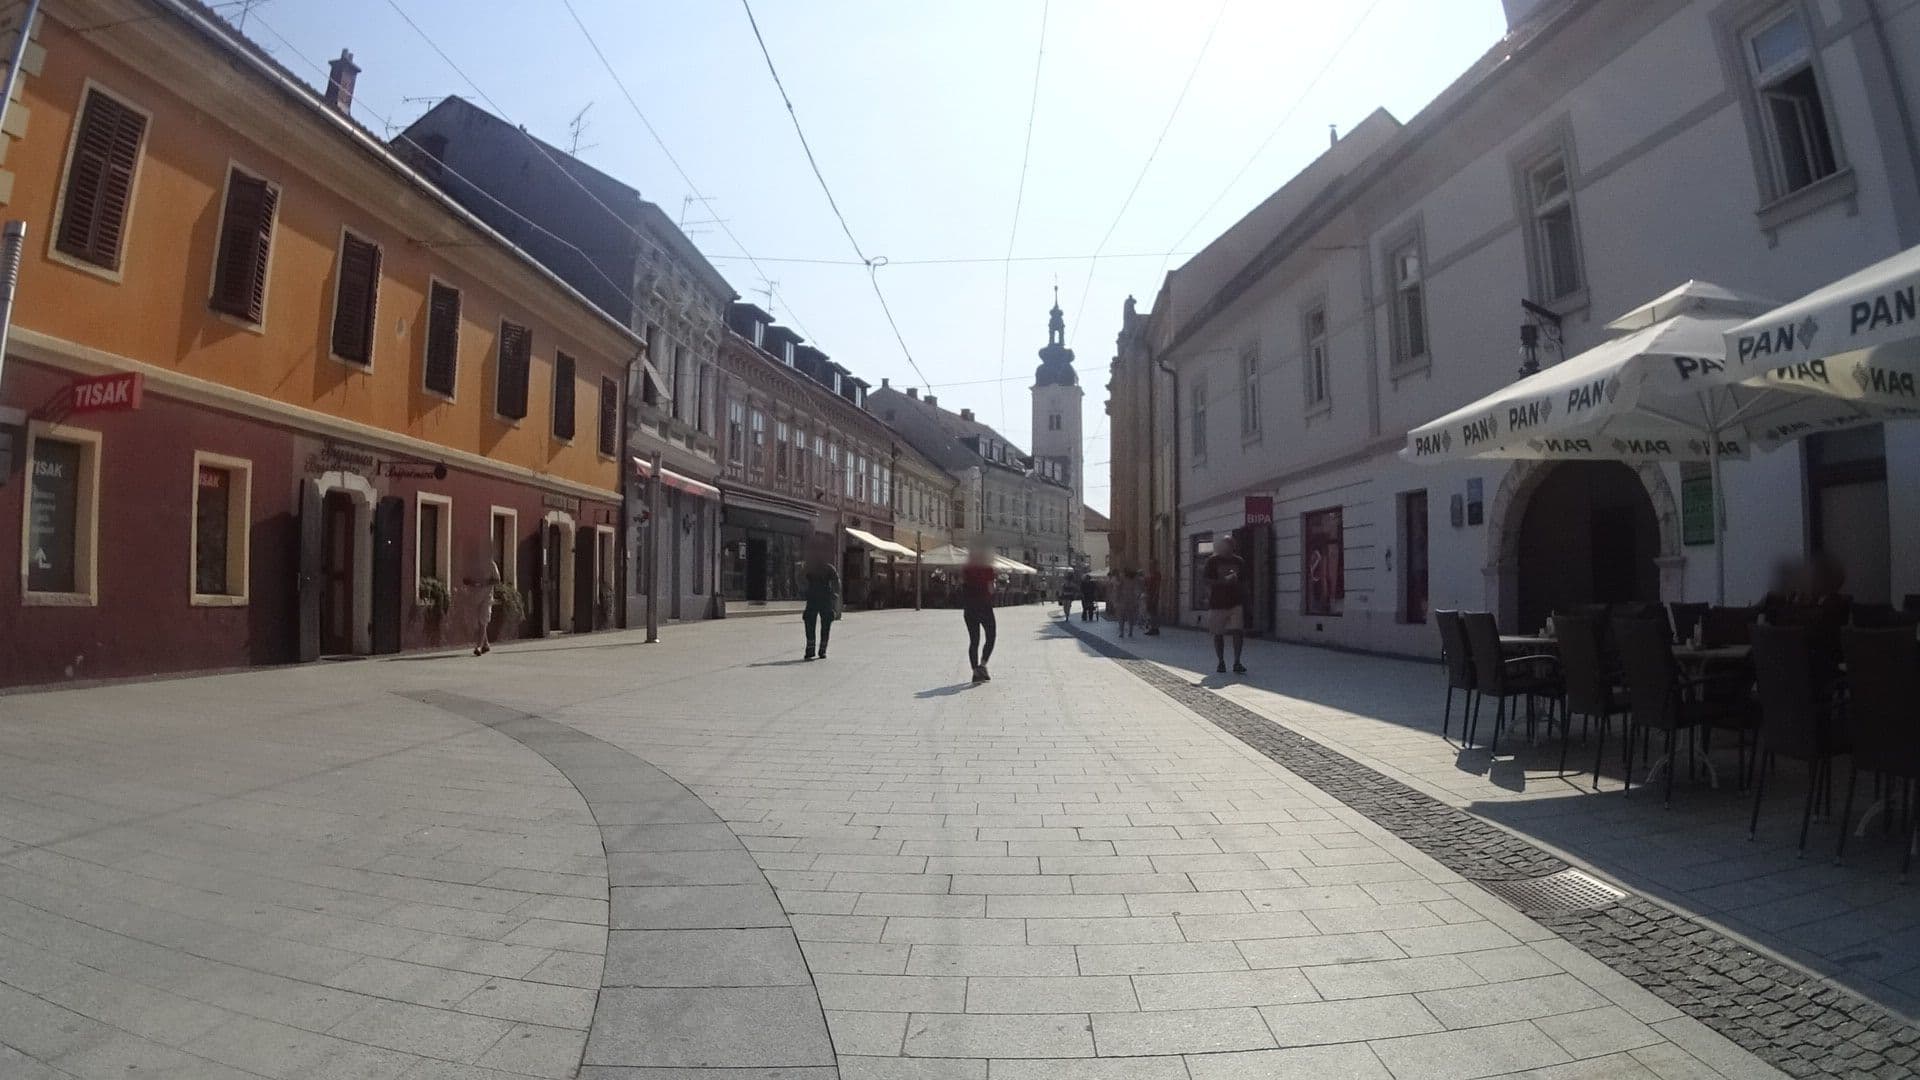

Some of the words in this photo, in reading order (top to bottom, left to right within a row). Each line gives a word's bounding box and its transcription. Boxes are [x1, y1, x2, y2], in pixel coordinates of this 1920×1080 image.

[1738, 325, 1794, 363] PAN
[1851, 288, 1915, 335] PAN
[1674, 357, 1726, 378] PA
[76, 380, 130, 406] TISAK
[1415, 435, 1440, 456] PAN
[1462, 418, 1489, 445] PAN
[1509, 401, 1539, 431] PAN
[1568, 379, 1604, 412] PAN
[1247, 514, 1272, 525] BIPA
